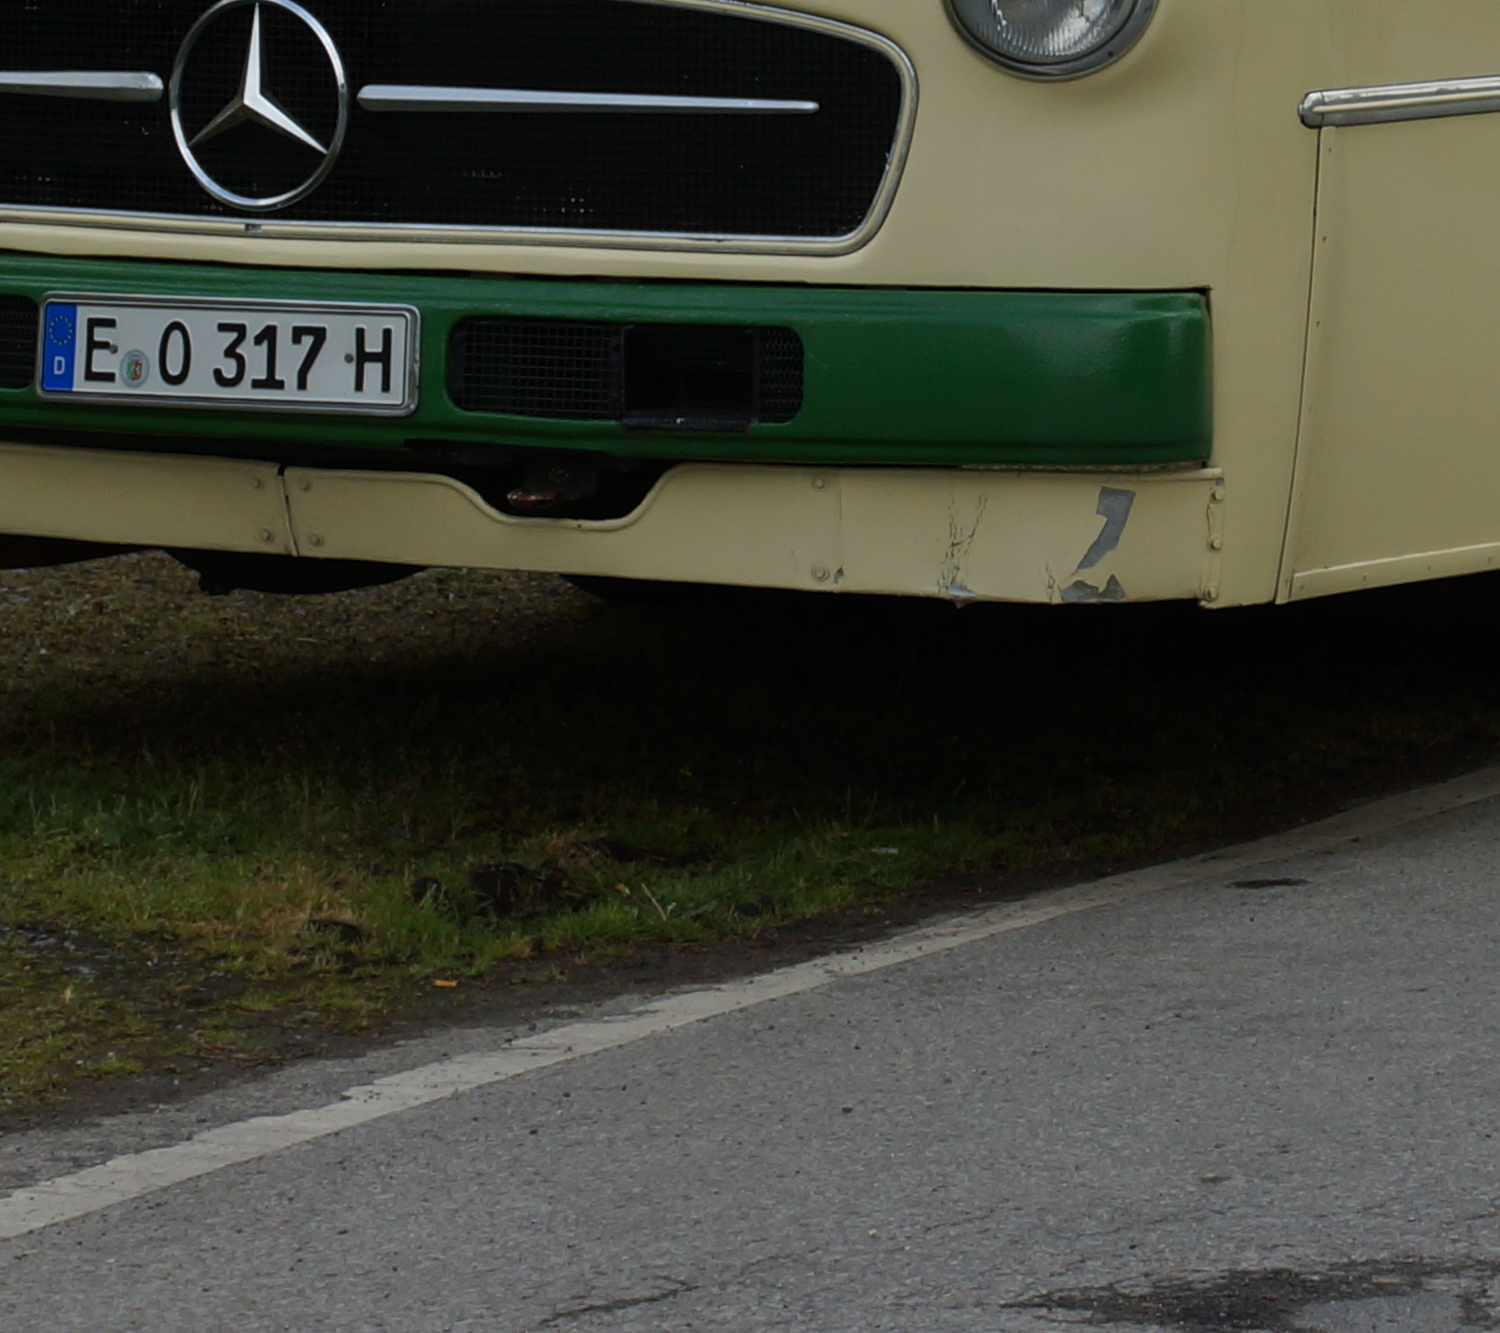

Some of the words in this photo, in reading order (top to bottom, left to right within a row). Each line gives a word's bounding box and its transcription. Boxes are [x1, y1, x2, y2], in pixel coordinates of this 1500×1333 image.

[52, 355, 66, 375] D
[84, 317, 118, 383] E
[212, 321, 328, 391] 317
[353, 326, 393, 393] H
